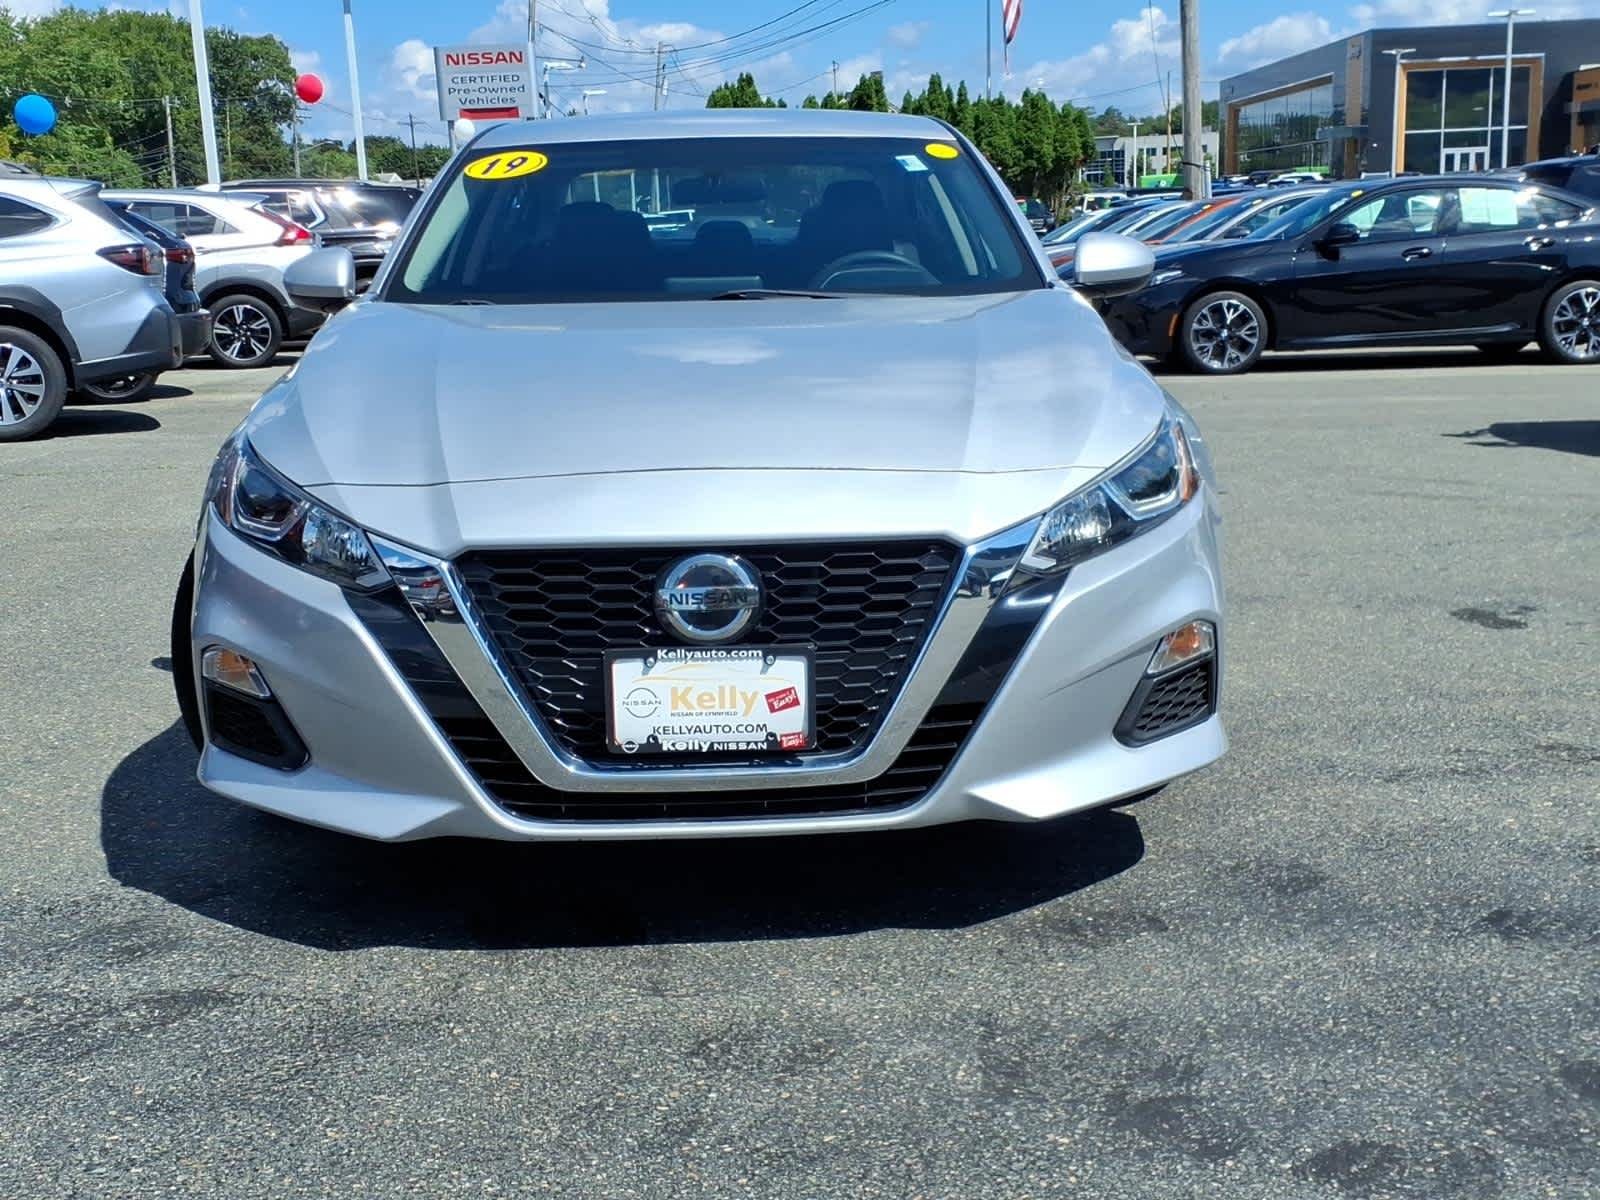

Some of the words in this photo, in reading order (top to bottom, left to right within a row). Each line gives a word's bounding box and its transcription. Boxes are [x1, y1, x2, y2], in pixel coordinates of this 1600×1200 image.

[446, 51, 523, 66] NISSAN
[451, 74, 520, 84] CERTIFIED
[448, 84, 525, 95] Pre-Owned
[459, 96, 516, 105] Vehicles
[481, 156, 528, 175] 19
[669, 592, 748, 606] NISSAN
[657, 648, 763, 663] Kellyauto.com
[670, 685, 759, 717] Kelly
[652, 723, 768, 735] KELLYAUTO.COM
[662, 738, 711, 752] Kelly
[713, 741, 767, 750] NISSAN
